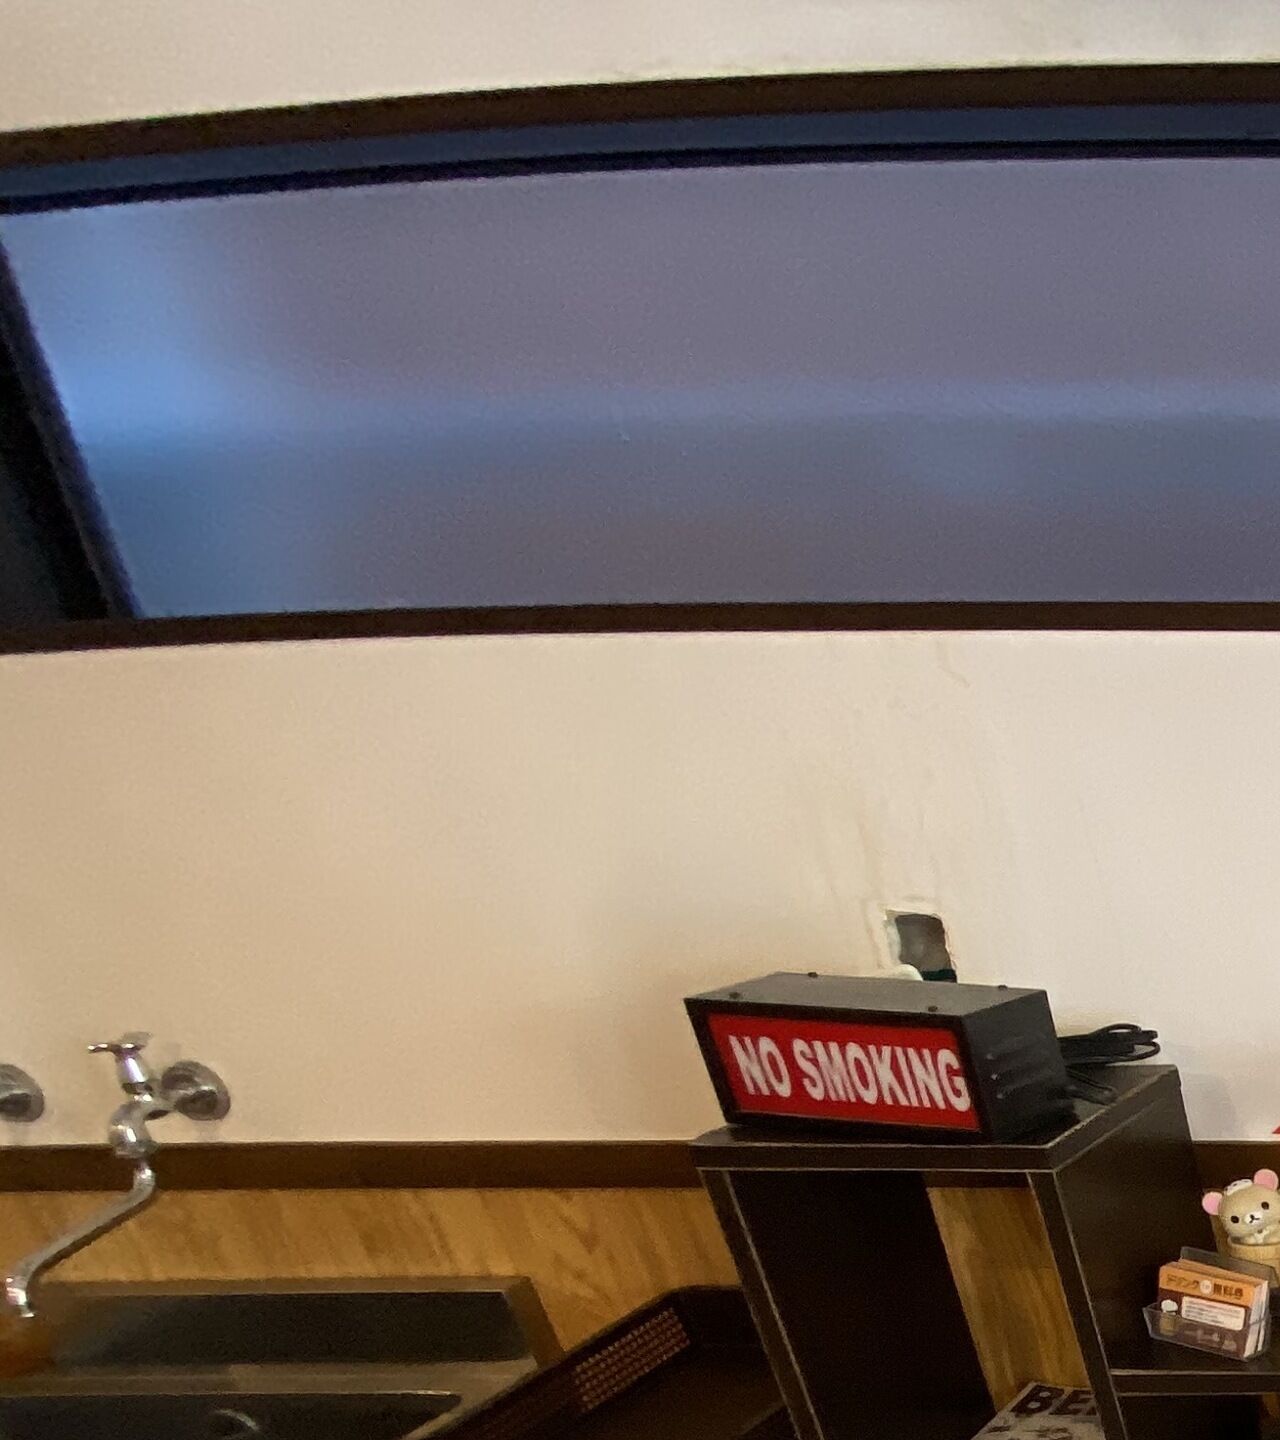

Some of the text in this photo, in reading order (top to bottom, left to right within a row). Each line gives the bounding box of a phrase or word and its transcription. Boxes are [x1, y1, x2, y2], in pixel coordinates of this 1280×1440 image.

[729, 1035, 971, 1112] NO SMOKING
[1011, 1385, 1097, 1416] BE
